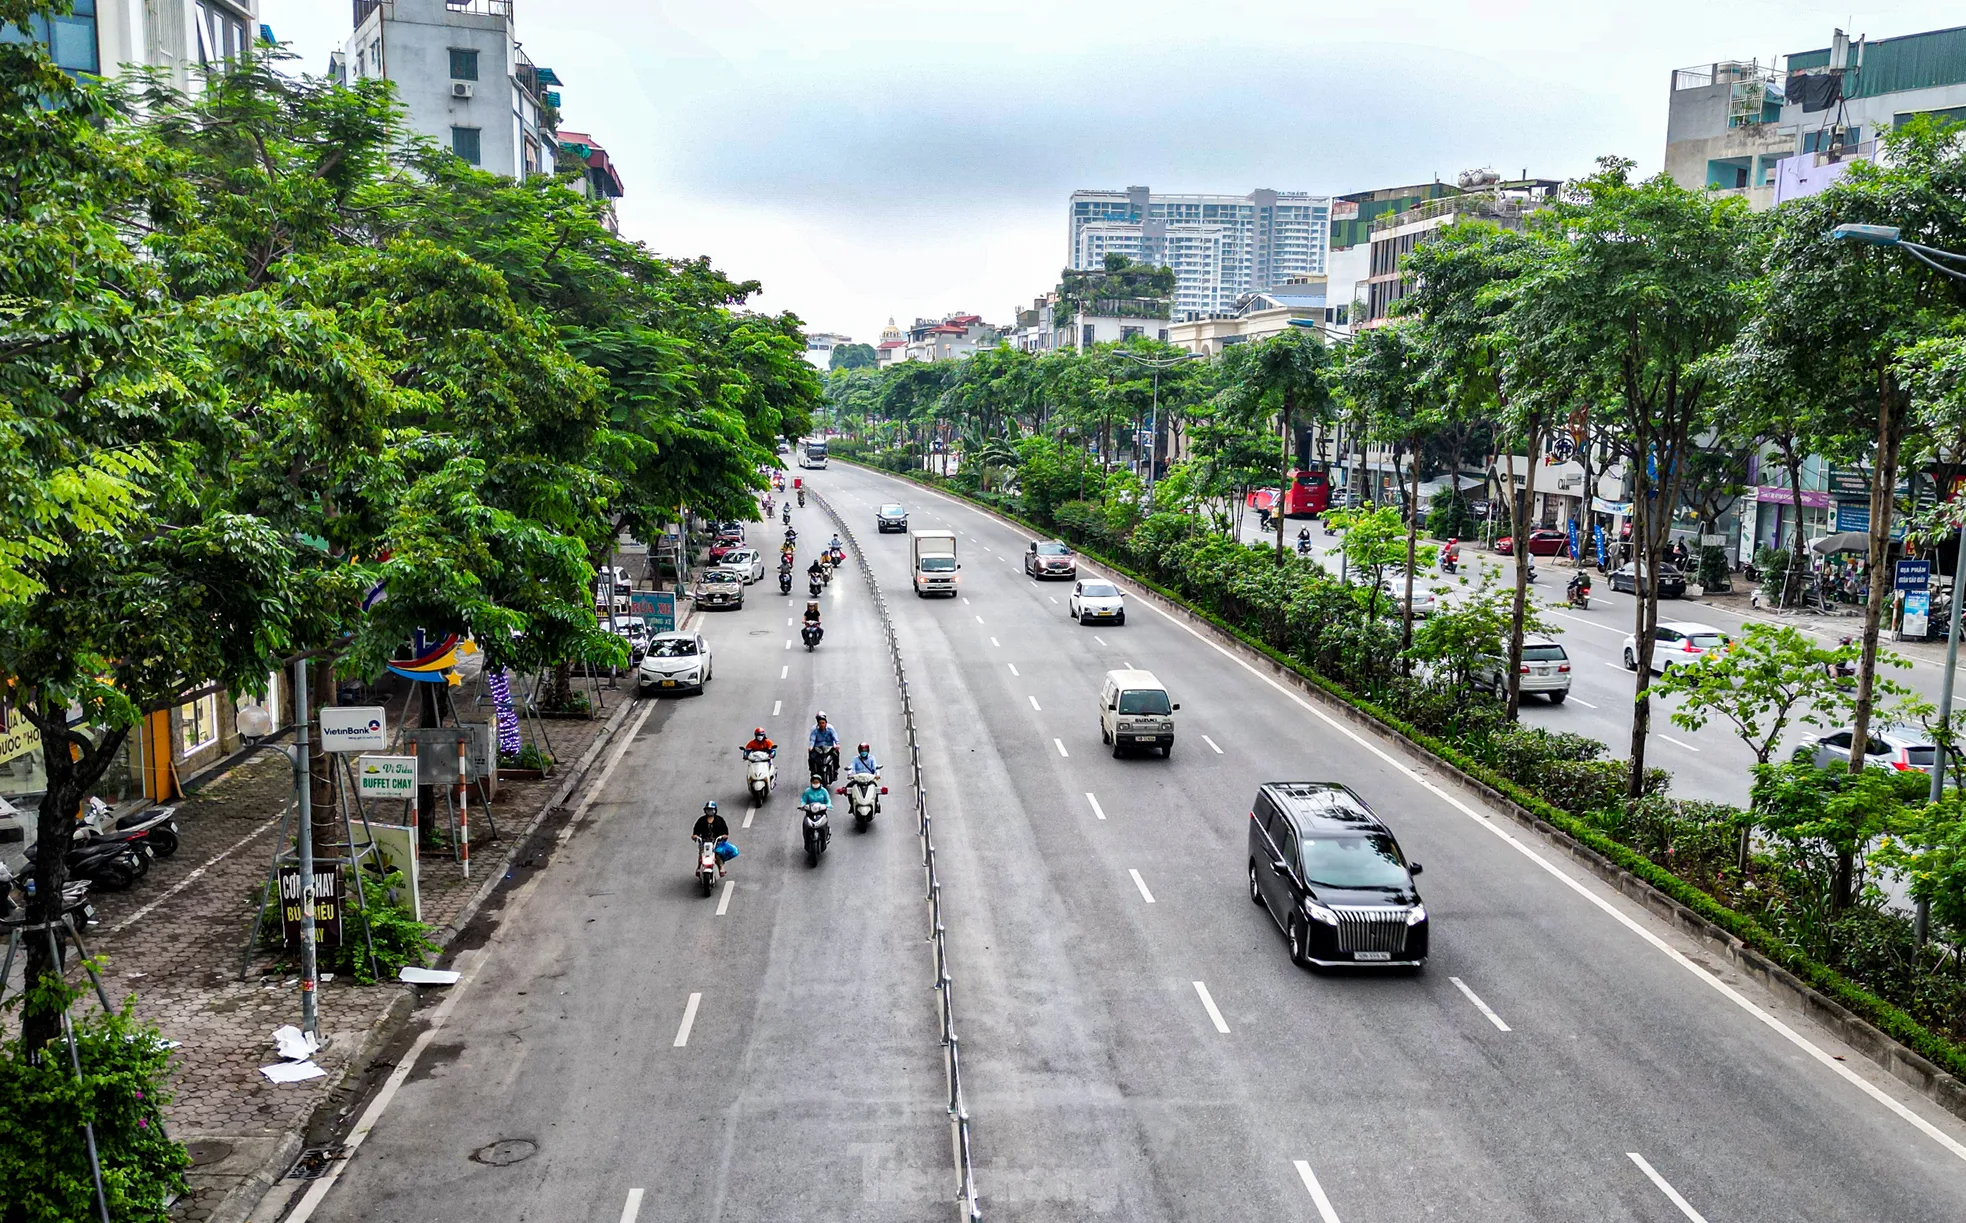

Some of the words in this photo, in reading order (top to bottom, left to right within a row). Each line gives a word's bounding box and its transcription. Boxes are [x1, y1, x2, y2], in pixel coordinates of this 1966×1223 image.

[324, 727, 369, 735] VietinBank
[363, 778, 390, 788] BUFFET
[392, 778, 412, 789] CHAY
[287, 903, 302, 922] BÚ
